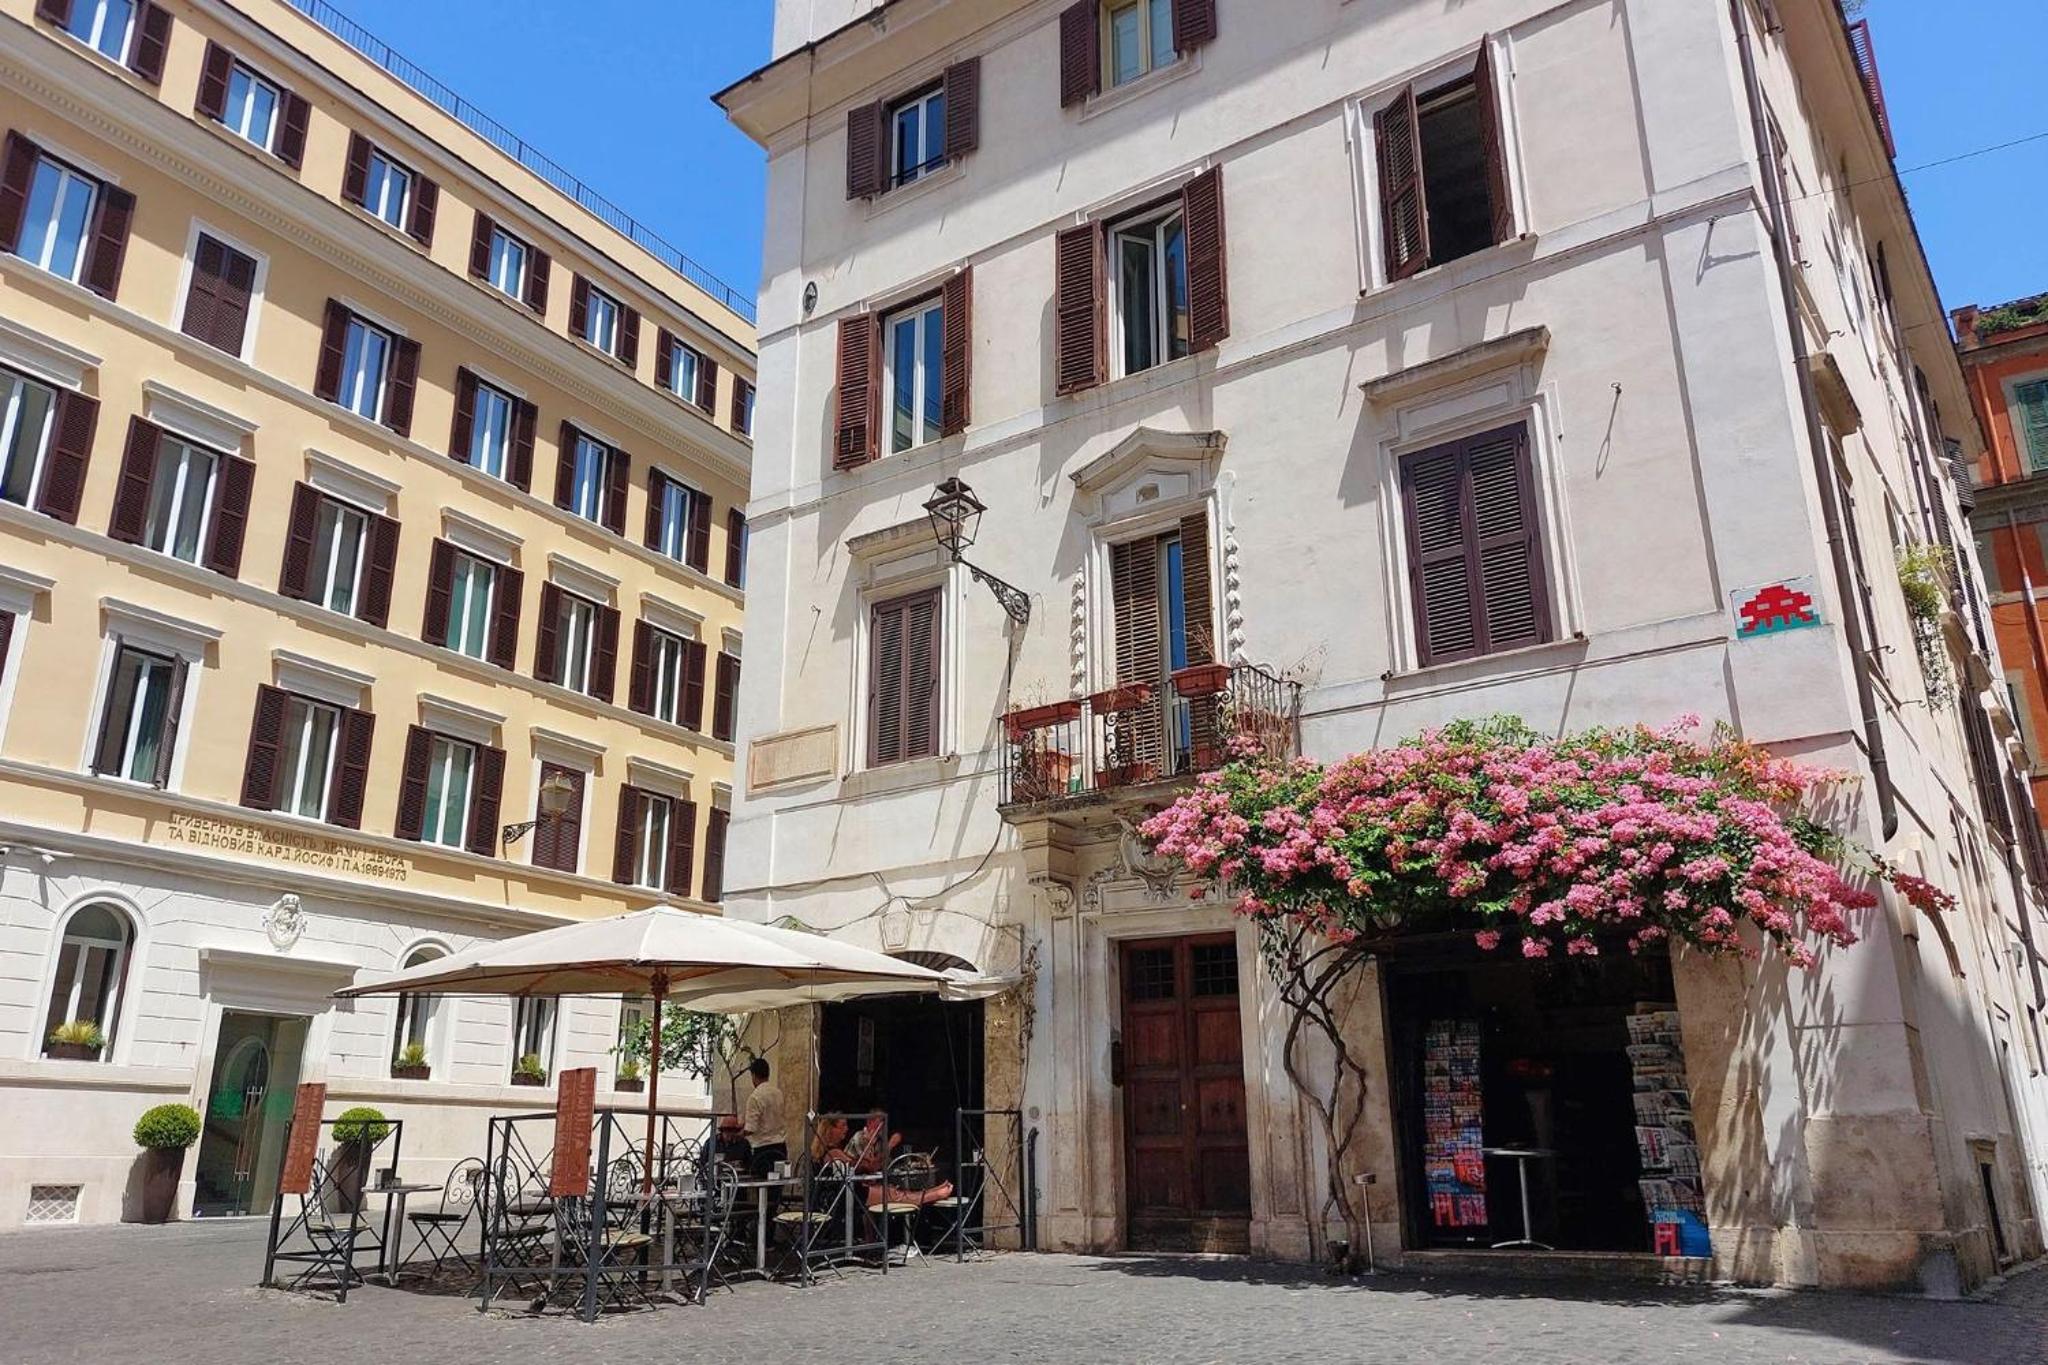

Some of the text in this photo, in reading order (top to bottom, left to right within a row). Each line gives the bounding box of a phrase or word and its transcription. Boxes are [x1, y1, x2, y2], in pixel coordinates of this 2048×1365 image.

[169, 826, 184, 841] ТА
[188, 829, 254, 853] ВІДНОВИВ
[294, 849, 334, 868] ЙОСИФ
